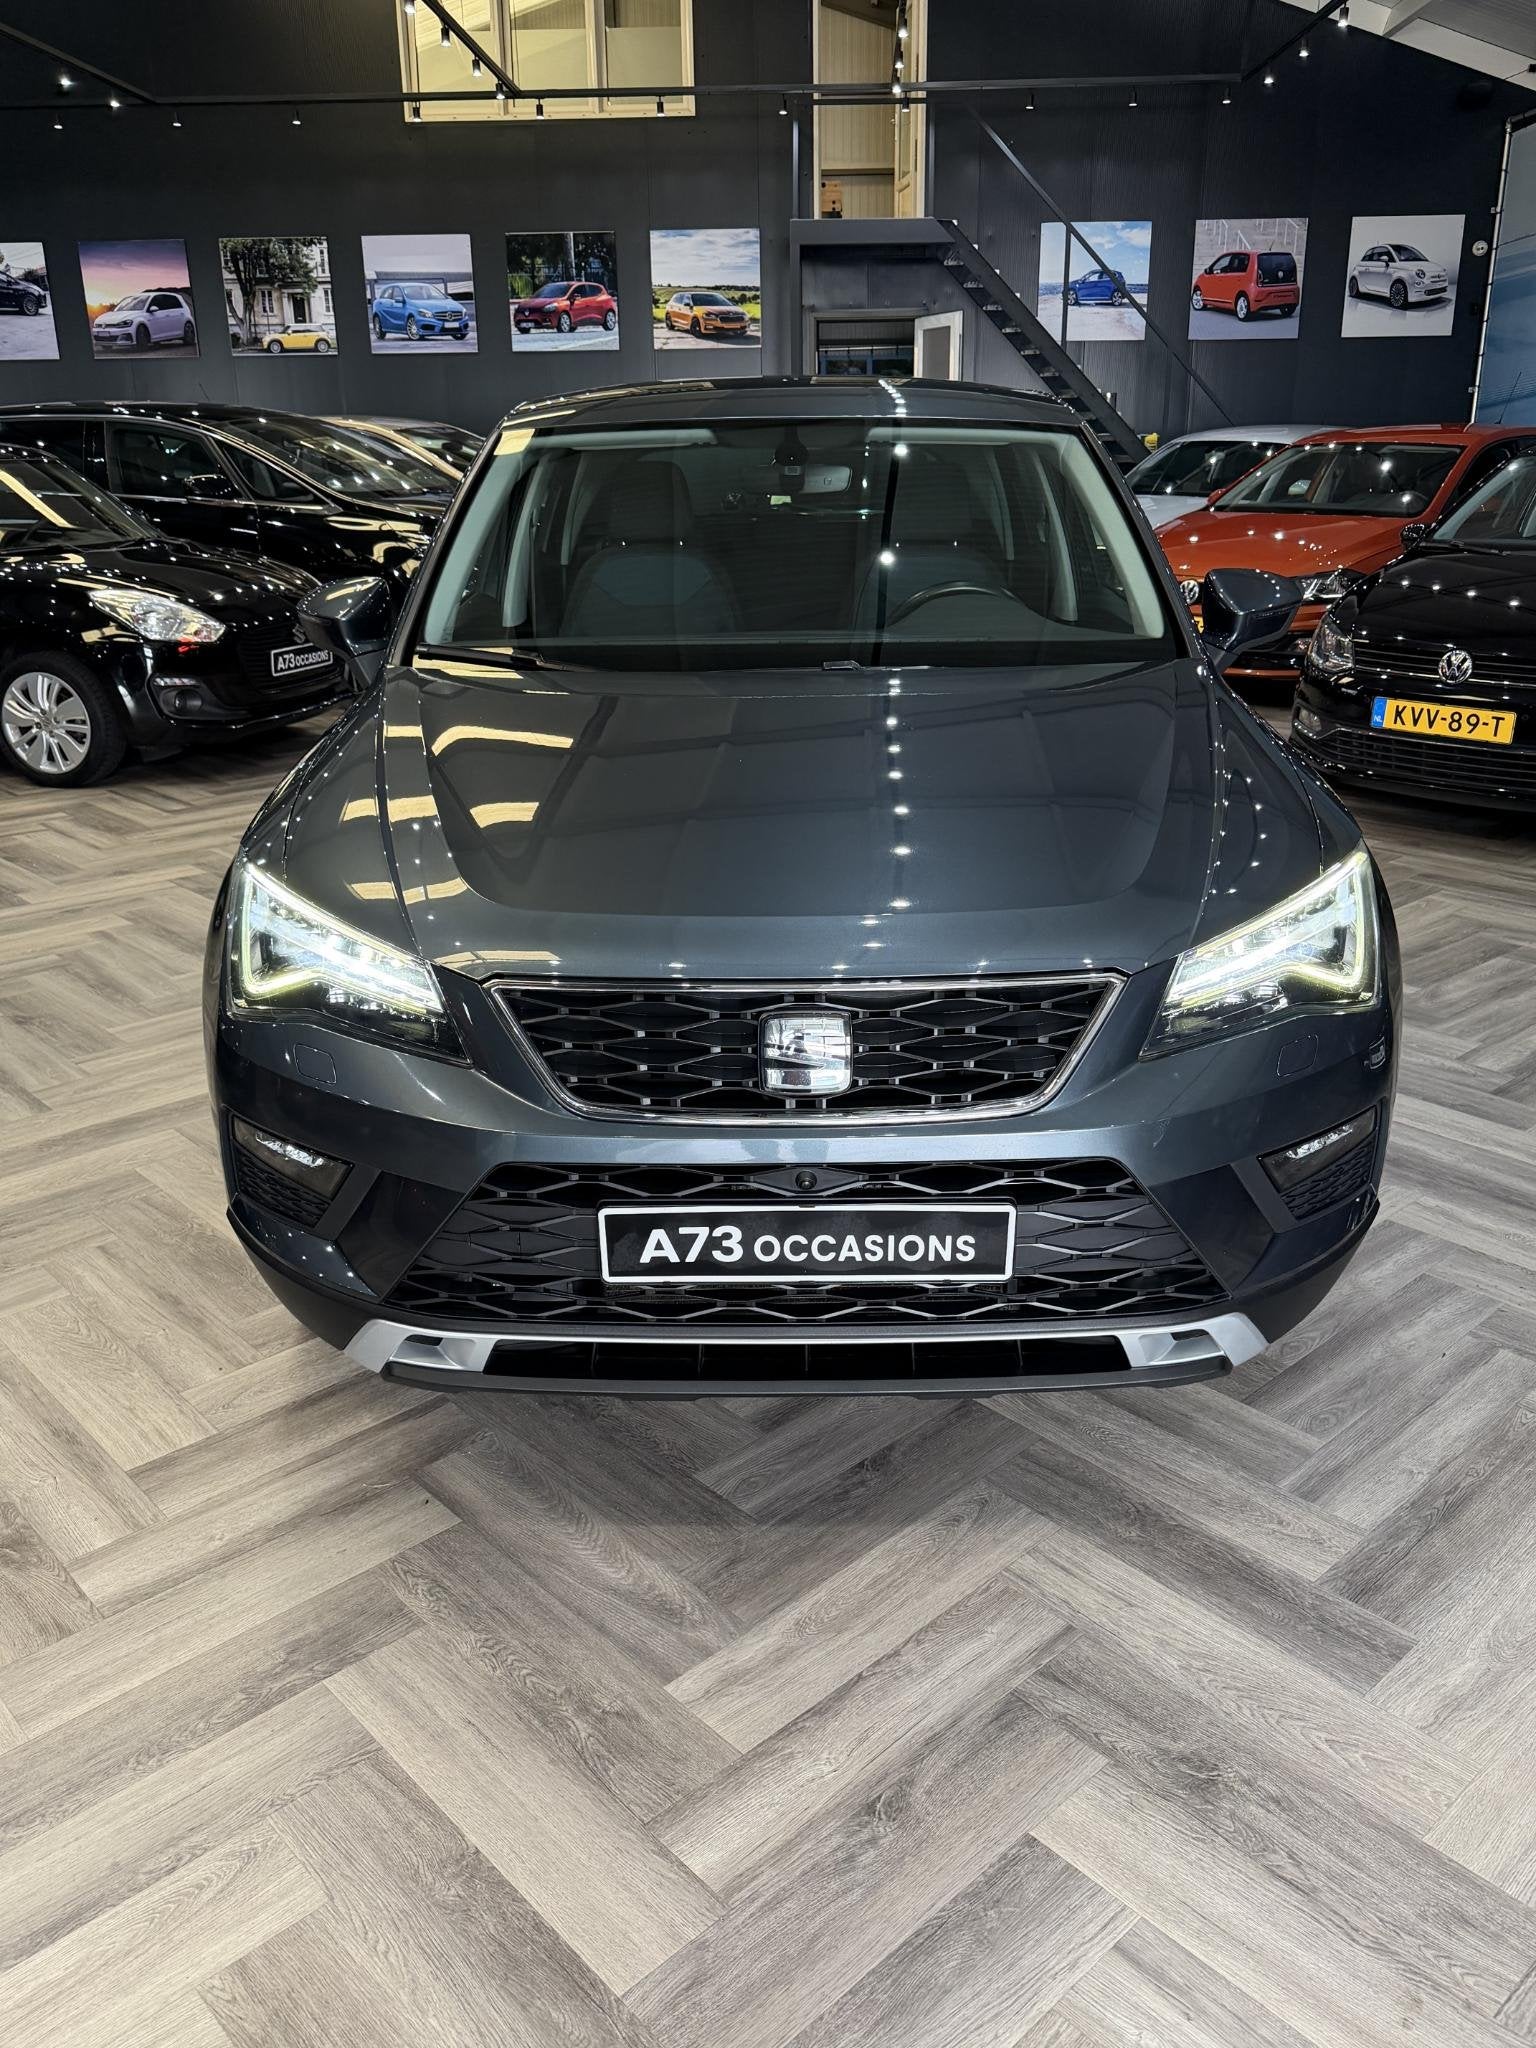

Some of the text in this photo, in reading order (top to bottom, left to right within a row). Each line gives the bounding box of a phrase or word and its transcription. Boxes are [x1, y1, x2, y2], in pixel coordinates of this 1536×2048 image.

[277, 650, 329, 670] A73 OCCASIONS
[1374, 704, 1506, 737] NL KVV-89-T
[639, 1225, 976, 1264] A73 OCCASIONS
